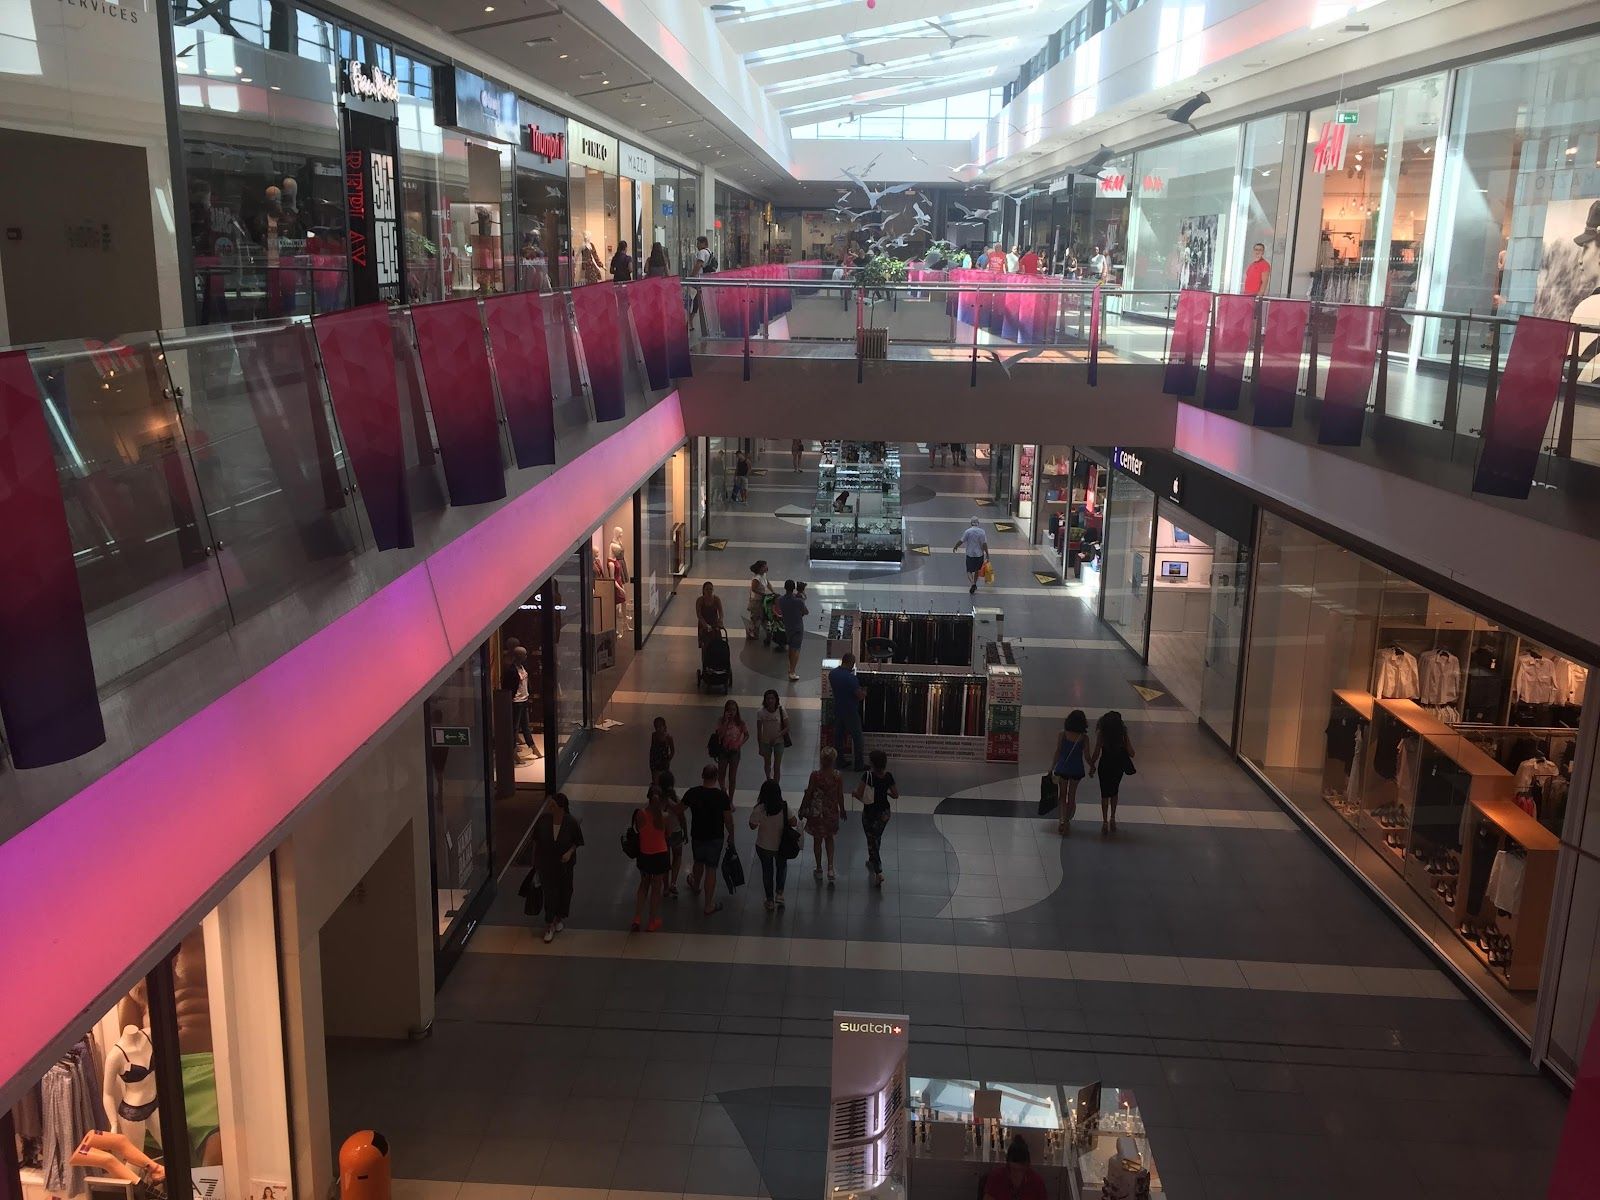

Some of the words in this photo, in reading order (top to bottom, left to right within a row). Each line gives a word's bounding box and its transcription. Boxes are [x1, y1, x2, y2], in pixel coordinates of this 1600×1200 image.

[528, 124, 563, 161] Triumph
[582, 138, 607, 161] PINKO
[840, 1023, 891, 1035] swatch
